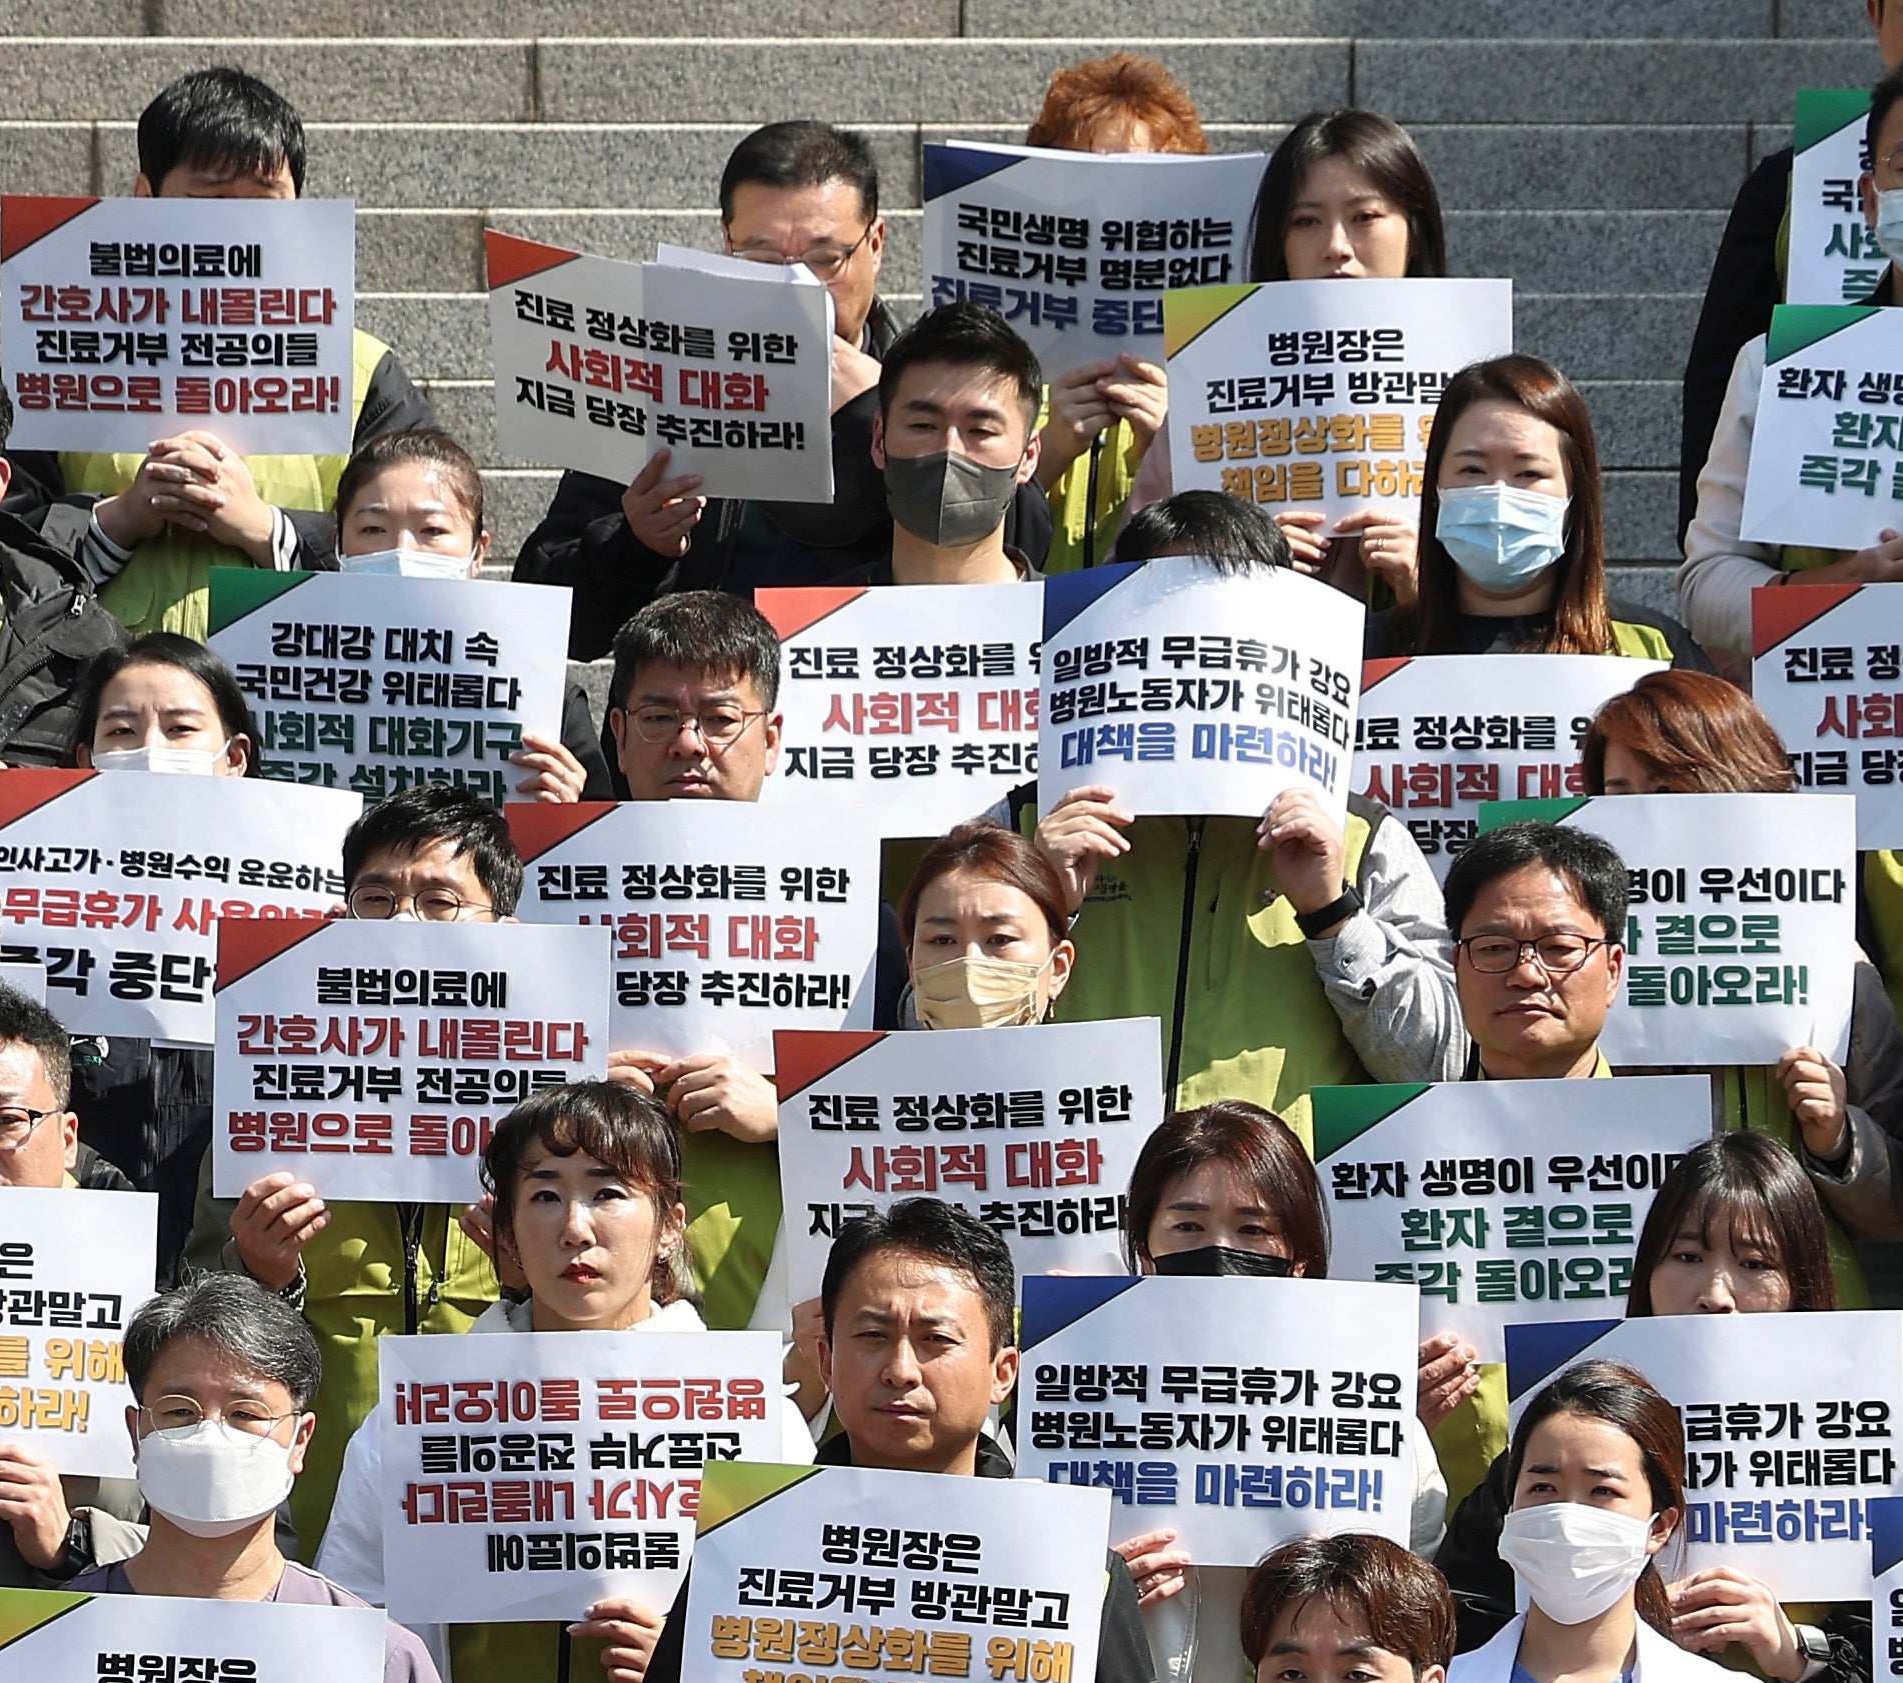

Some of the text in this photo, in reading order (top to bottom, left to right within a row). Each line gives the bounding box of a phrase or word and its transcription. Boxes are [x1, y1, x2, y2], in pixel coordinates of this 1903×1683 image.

[957, 203, 1233, 253] 국민생명 위협하는
[89, 241, 261, 278] 불법의료에
[957, 241, 1233, 291] 진료거부 명분없다
[20, 284, 337, 327] 간호사가 내몰린다
[514, 289, 799, 365] 진료 정상화를 위한
[35, 329, 318, 368] 진료거부 전공의들
[16, 372, 340, 415] 병원으로 돌아오라!
[545, 339, 770, 413] 사회적 대화
[1777, 367, 1848, 402] 환자
[515, 376, 805, 451] 지금 당장 추진하라!
[1799, 454, 1882, 498] 즉각
[1053, 635, 1351, 709] 일방적 무급휴가 강요
[1049, 678, 1350, 755] 병원노동자가 위태롭다
[1060, 722, 1337, 789] 대책을 마련하라!
[1034, 1364, 1319, 1407] 일방적 무급휴가
[1031, 1411, 1404, 1458] 병원노동자가 위태롭다
[1194, 1463, 1383, 1512] 마련하라!
